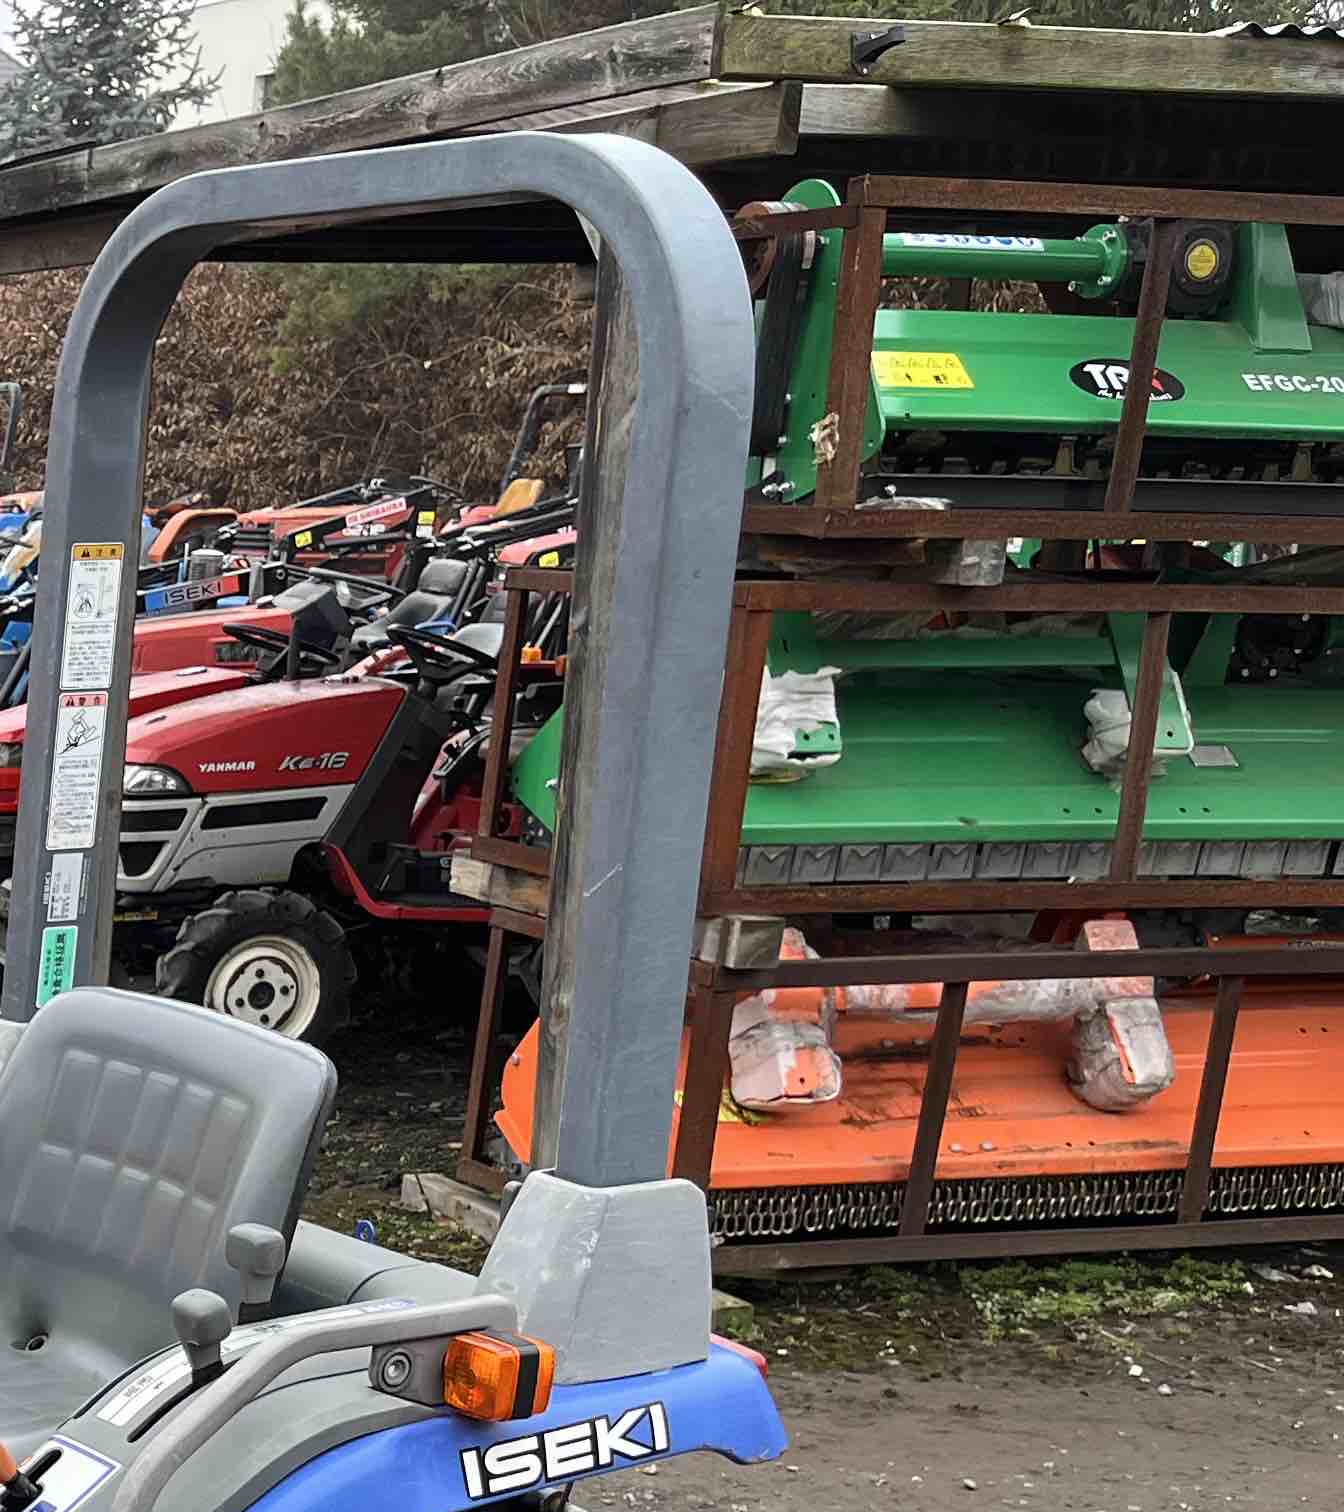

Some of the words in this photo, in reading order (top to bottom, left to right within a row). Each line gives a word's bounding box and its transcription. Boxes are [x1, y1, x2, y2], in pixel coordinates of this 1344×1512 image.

[164, 581, 221, 604] ISEKI
[198, 760, 256, 773] YANMAR
[460, 1401, 671, 1500] ISEKI
